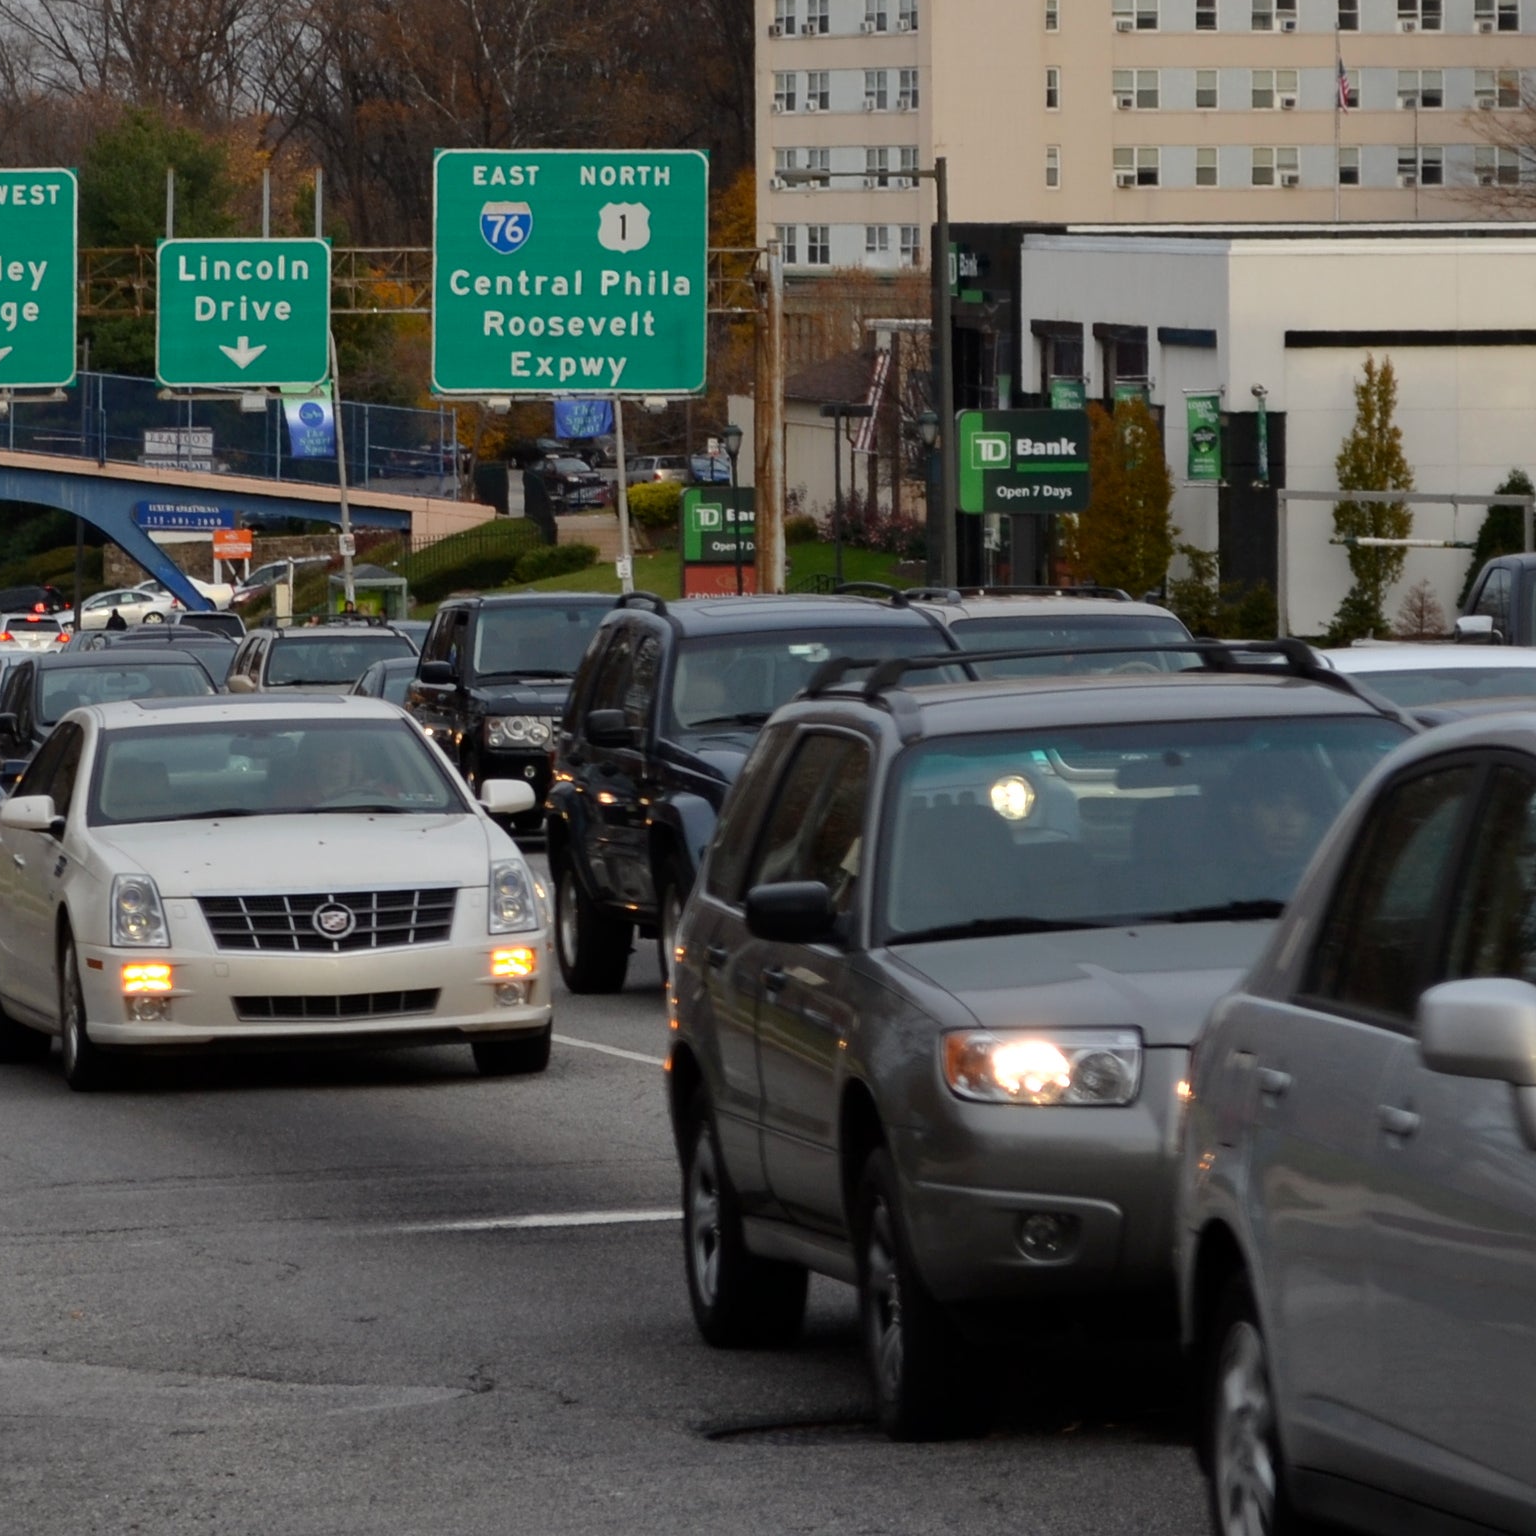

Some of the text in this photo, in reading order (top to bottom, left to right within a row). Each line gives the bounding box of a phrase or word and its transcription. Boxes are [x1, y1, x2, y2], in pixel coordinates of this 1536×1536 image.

[473, 166, 670, 186] EAST NORTH
[486, 216, 524, 244] 76
[619, 214, 627, 240] 1
[178, 255, 309, 281] Lincoln
[450, 269, 691, 296] Central Phila
[194, 295, 292, 321] Drive
[483, 310, 655, 336] Roosevelt
[511, 351, 627, 387] Expwy
[975, 438, 1077, 462] TD Bank
[996, 485, 1072, 500] Open 7 Days
[695, 509, 719, 526] TD
[712, 541, 736, 552] Open
